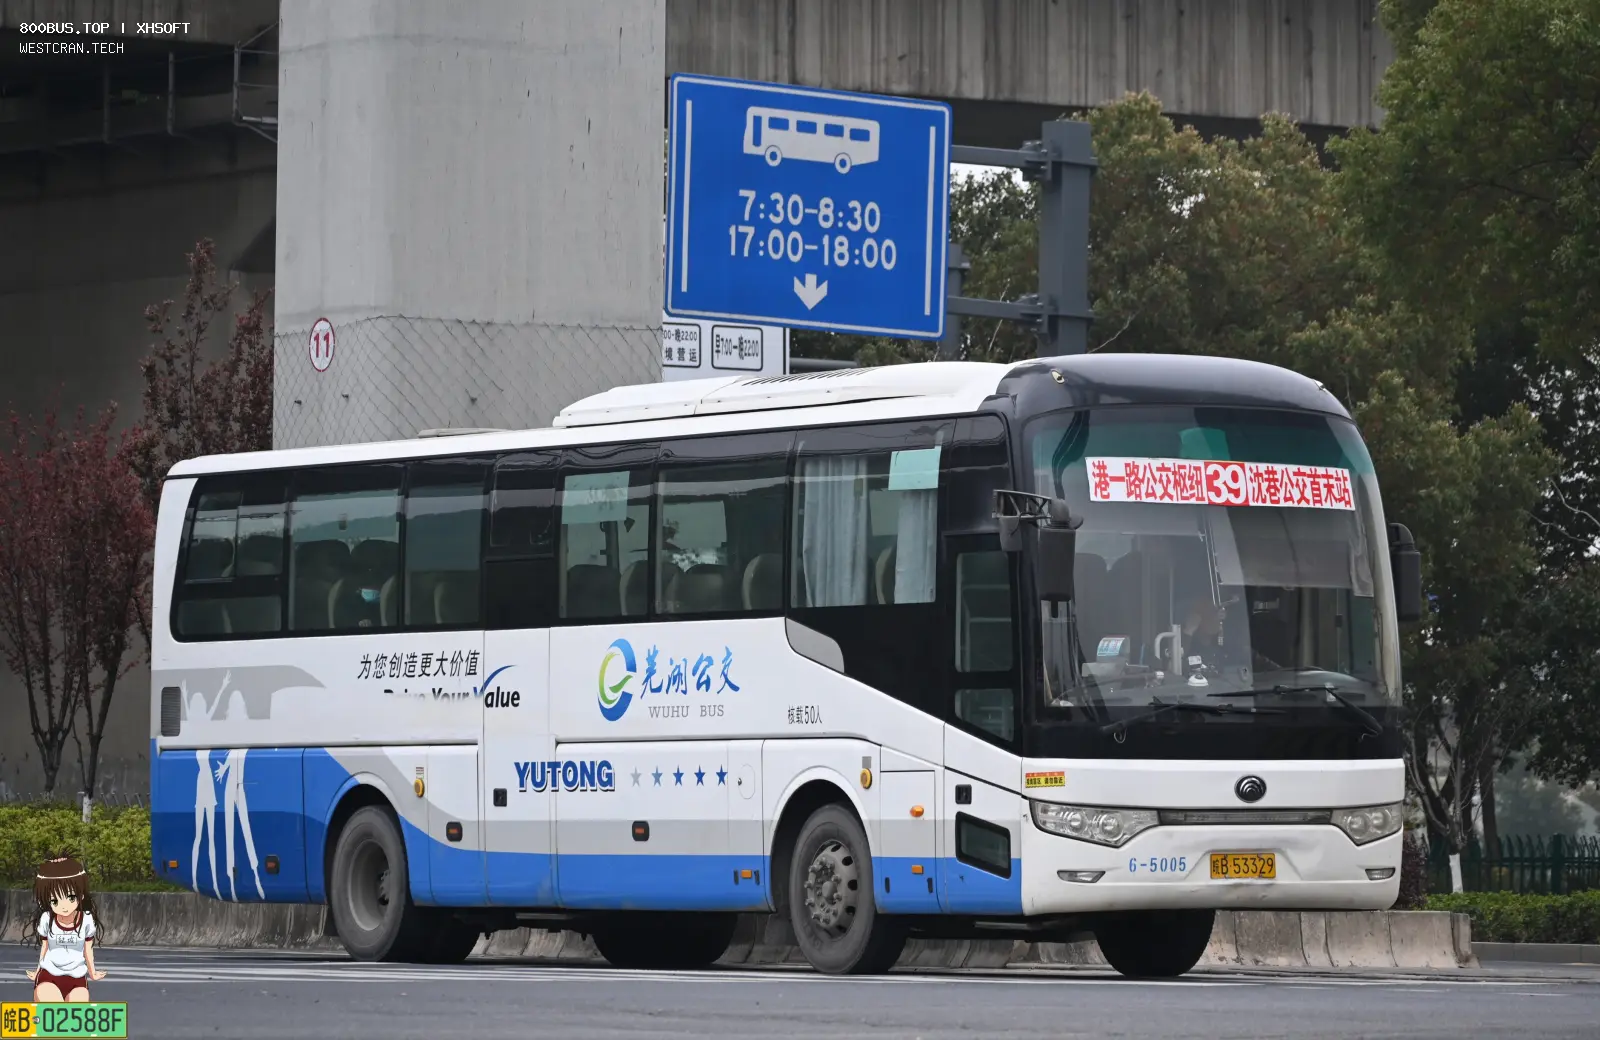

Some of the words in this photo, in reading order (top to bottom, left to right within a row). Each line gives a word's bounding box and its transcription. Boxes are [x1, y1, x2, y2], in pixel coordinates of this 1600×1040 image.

[738, 189, 881, 233] 7:30-8:30
[729, 224, 897, 270] 17:00-18:00
[313, 331, 330, 358] 11
[1092, 460, 1205, 502] 港一路公交枢纽
[1206, 463, 1247, 504] 39
[1249, 465, 1352, 508] 沈巷公交首末站
[357, 649, 480, 679] 为您创造更大价值
[640, 645, 741, 699] 芜湖公交
[649, 706, 690, 718] WUHU
[700, 705, 725, 717] BUS
[787, 705, 823, 724] 核载50人
[514, 760, 615, 792] YUTONG
[1129, 857, 1186, 872] 6-5005
